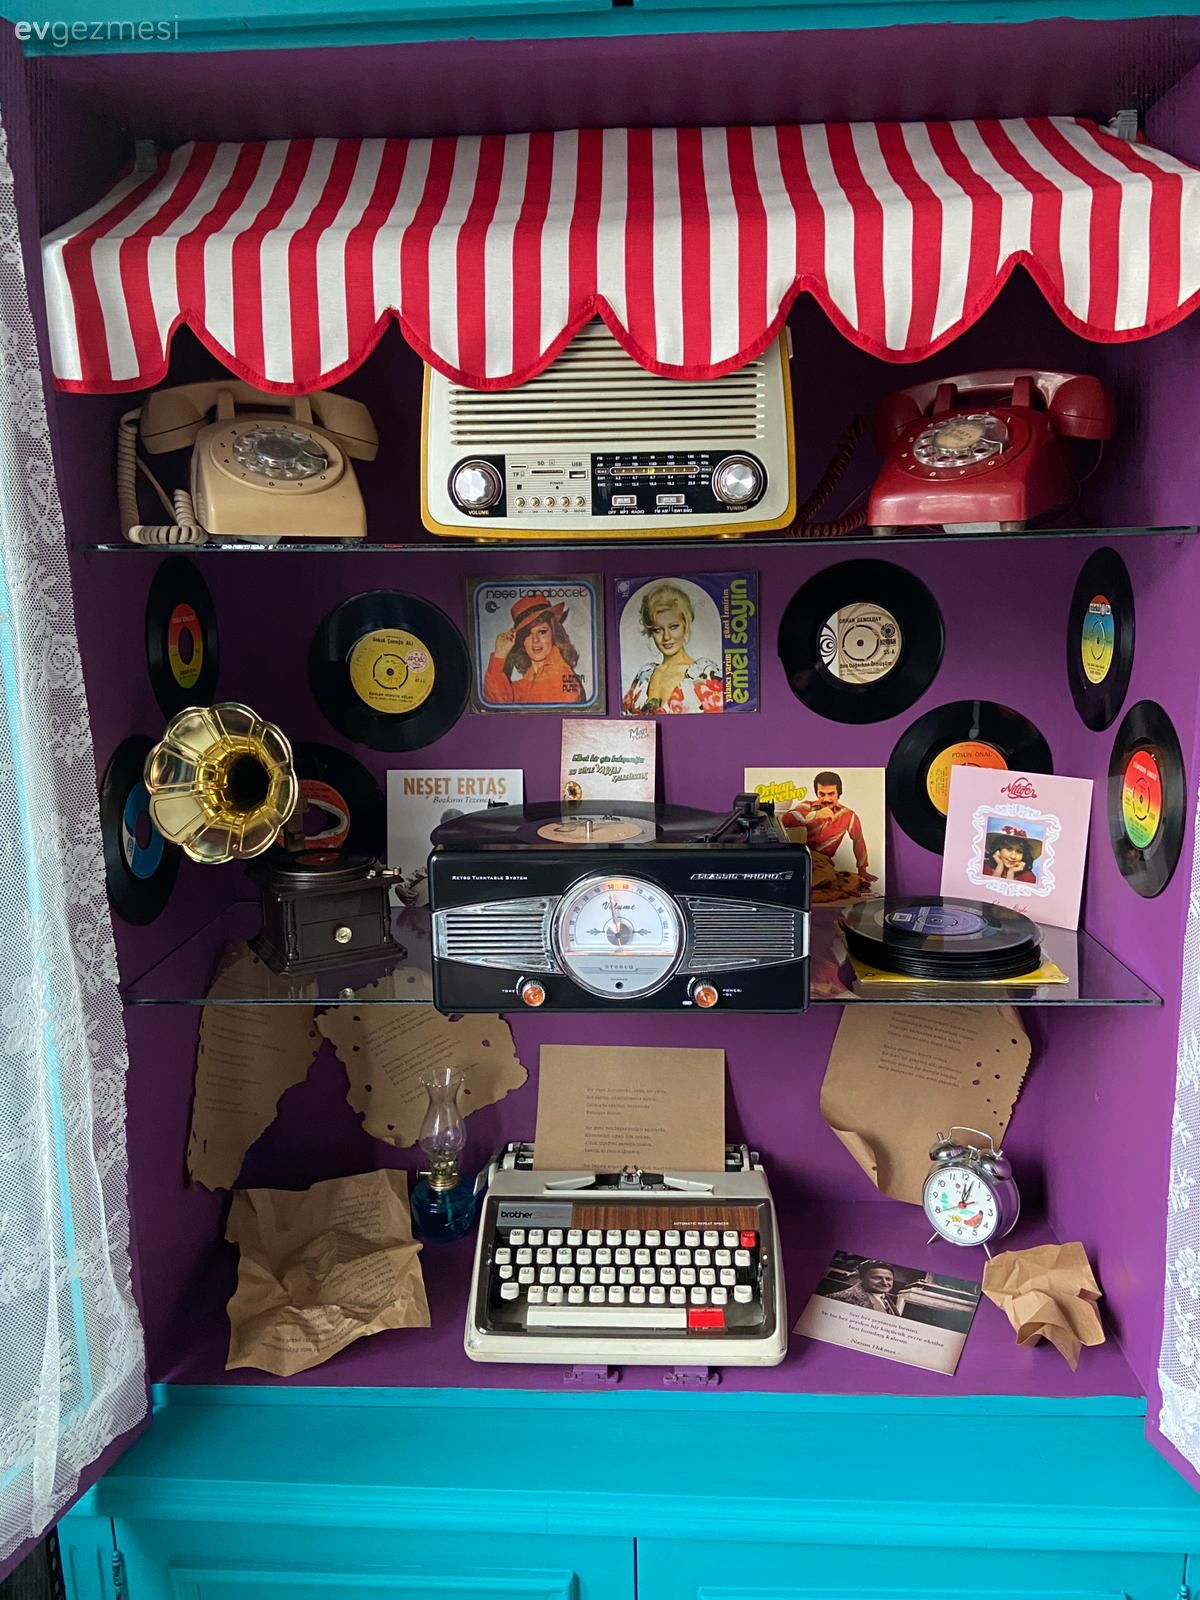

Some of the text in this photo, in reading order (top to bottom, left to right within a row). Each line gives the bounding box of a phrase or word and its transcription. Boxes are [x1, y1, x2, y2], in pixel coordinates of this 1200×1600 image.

[730, 579, 756, 644] sayın
[724, 648, 750, 704] emel
[403, 777, 506, 799] NEŞET ERTAŞ
[962, 1173, 970, 1181] 12
[501, 1211, 533, 1219] brother
[988, 1209, 994, 1217] 3
